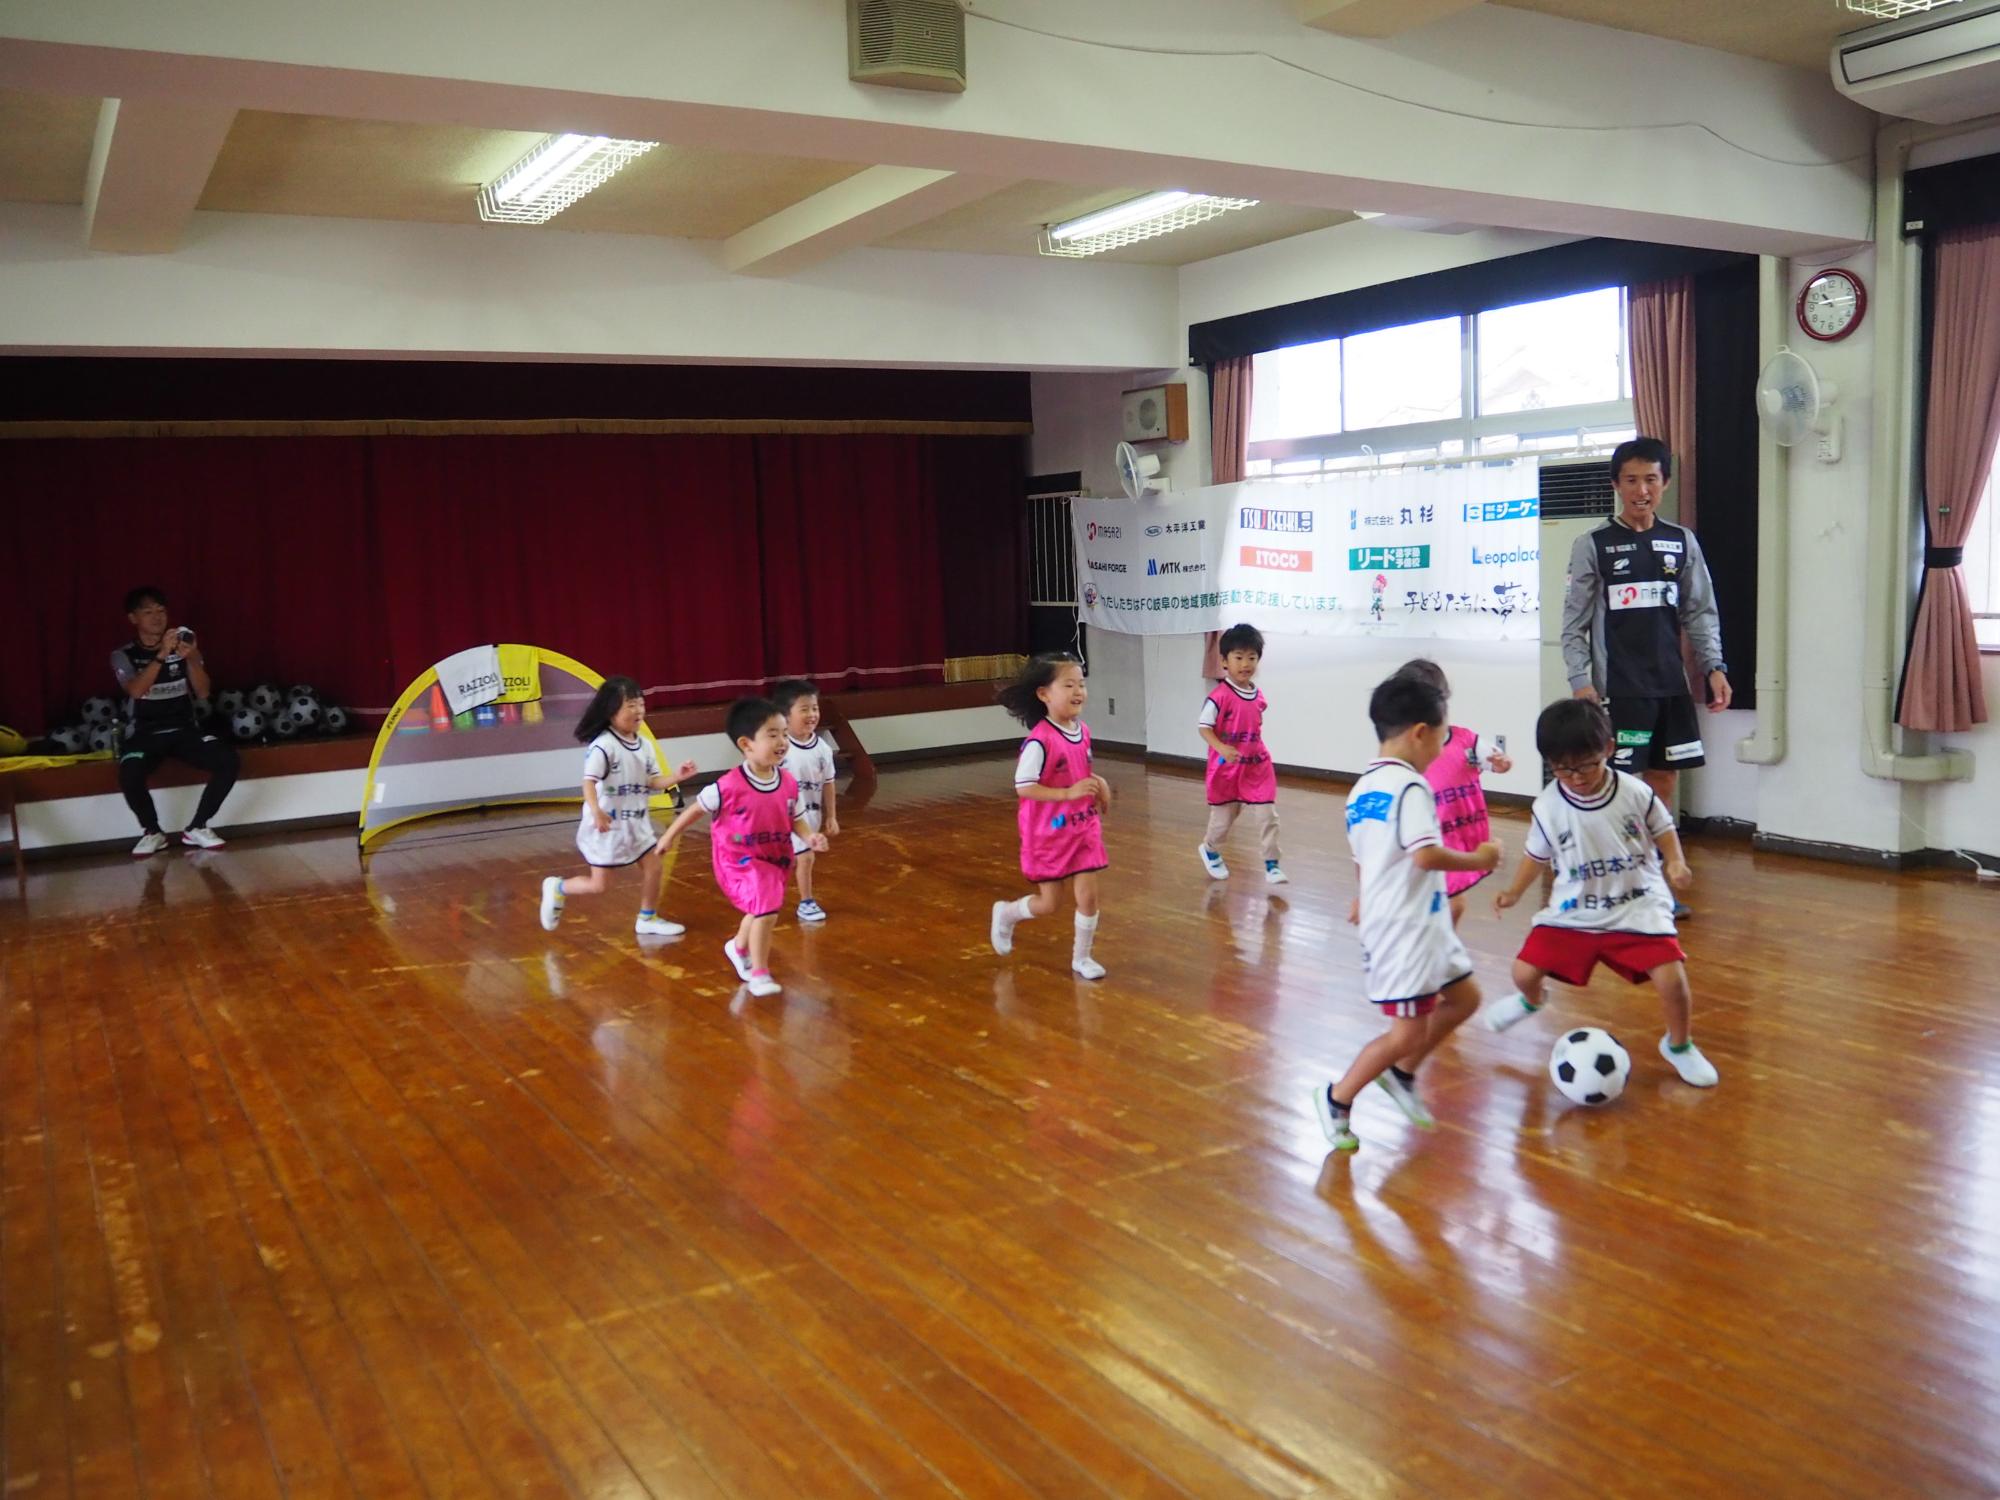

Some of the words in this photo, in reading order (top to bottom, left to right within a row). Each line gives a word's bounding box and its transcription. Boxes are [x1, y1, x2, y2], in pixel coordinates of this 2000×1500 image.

[1400, 504, 1434, 525] 丸杉
[1165, 520, 1206, 534] 太平洋工業
[1357, 548, 1396, 569] リード
[1159, 562, 1181, 575] MTK
[458, 672, 499, 696] RAZZOLI
[503, 677, 531, 687] ZZOLI
